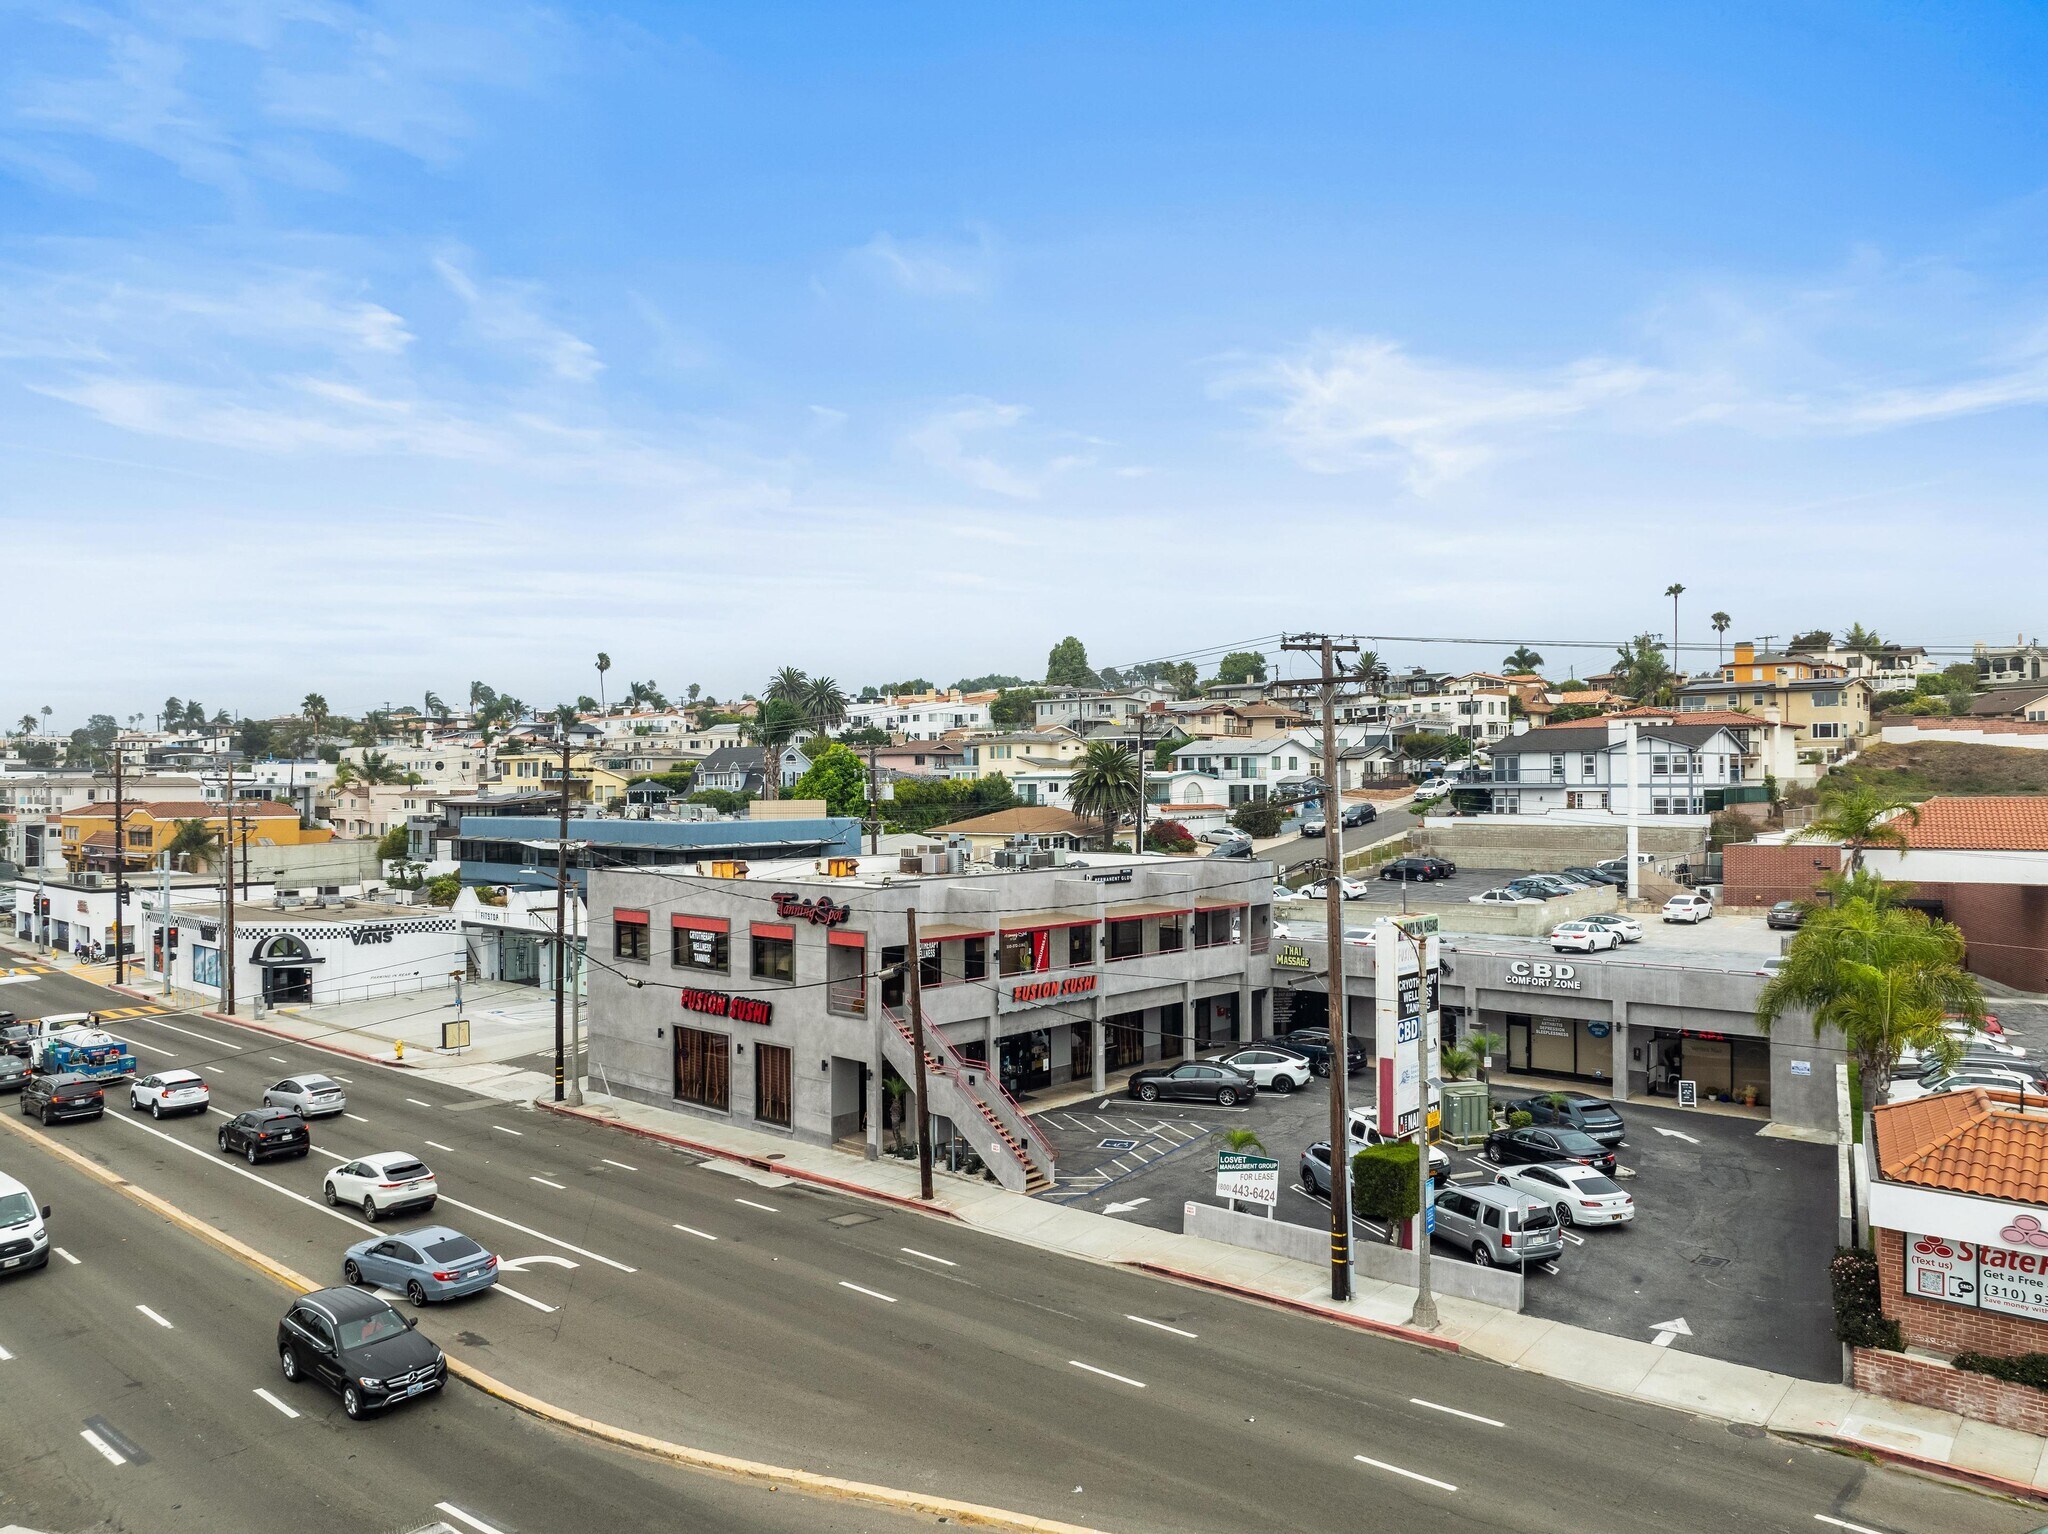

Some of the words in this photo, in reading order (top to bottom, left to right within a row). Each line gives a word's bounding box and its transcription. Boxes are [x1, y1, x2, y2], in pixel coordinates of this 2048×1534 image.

[771, 892, 815, 924] Tanning
[814, 897, 848, 926] Spot
[350, 924, 393, 946] VANS
[689, 930, 716, 942] CRYOTHERAPY
[692, 941, 712, 953] WELLNESS
[1283, 945, 1302, 956] THAI
[693, 953, 711, 964] TANNING
[1276, 954, 1310, 967] MASSAGE
[1510, 961, 1575, 980] CBD
[1012, 980, 1060, 1003] FUSION
[1062, 975, 1098, 996] SUSHI
[1398, 972, 1437, 992] CRYOTHAPY
[1505, 975, 1551, 987] COMFORT
[1553, 980, 1581, 990] ZONE
[1403, 986, 1432, 1003] WELLSS
[681, 988, 729, 1017] FUSION
[729, 996, 771, 1025] SUSHI
[1398, 1019, 1418, 1042] CBD
[1536, 1029, 1569, 1037] SLEEPLESSNESS
[1220, 1156, 1247, 1164] LOSVET
[1240, 1173, 1253, 1181] FOR
[1254, 1172, 1275, 1181] LEASE
[1218, 1183, 1232, 1192] (800)
[1232, 1183, 1276, 1203] 443-6424
[1911, 1255, 1935, 1267] (Text
[1938, 1261, 1953, 1271] us)
[1983, 1269, 2005, 1281] Get
[2007, 1275, 2015, 1283] a
[2018, 1275, 2044, 1288] Free
[1959, 1283, 1973, 1291] SMS
[1984, 1283, 2026, 1303] (310)
[1984, 1297, 2001, 1305] Save
[2003, 1301, 2030, 1312] money
